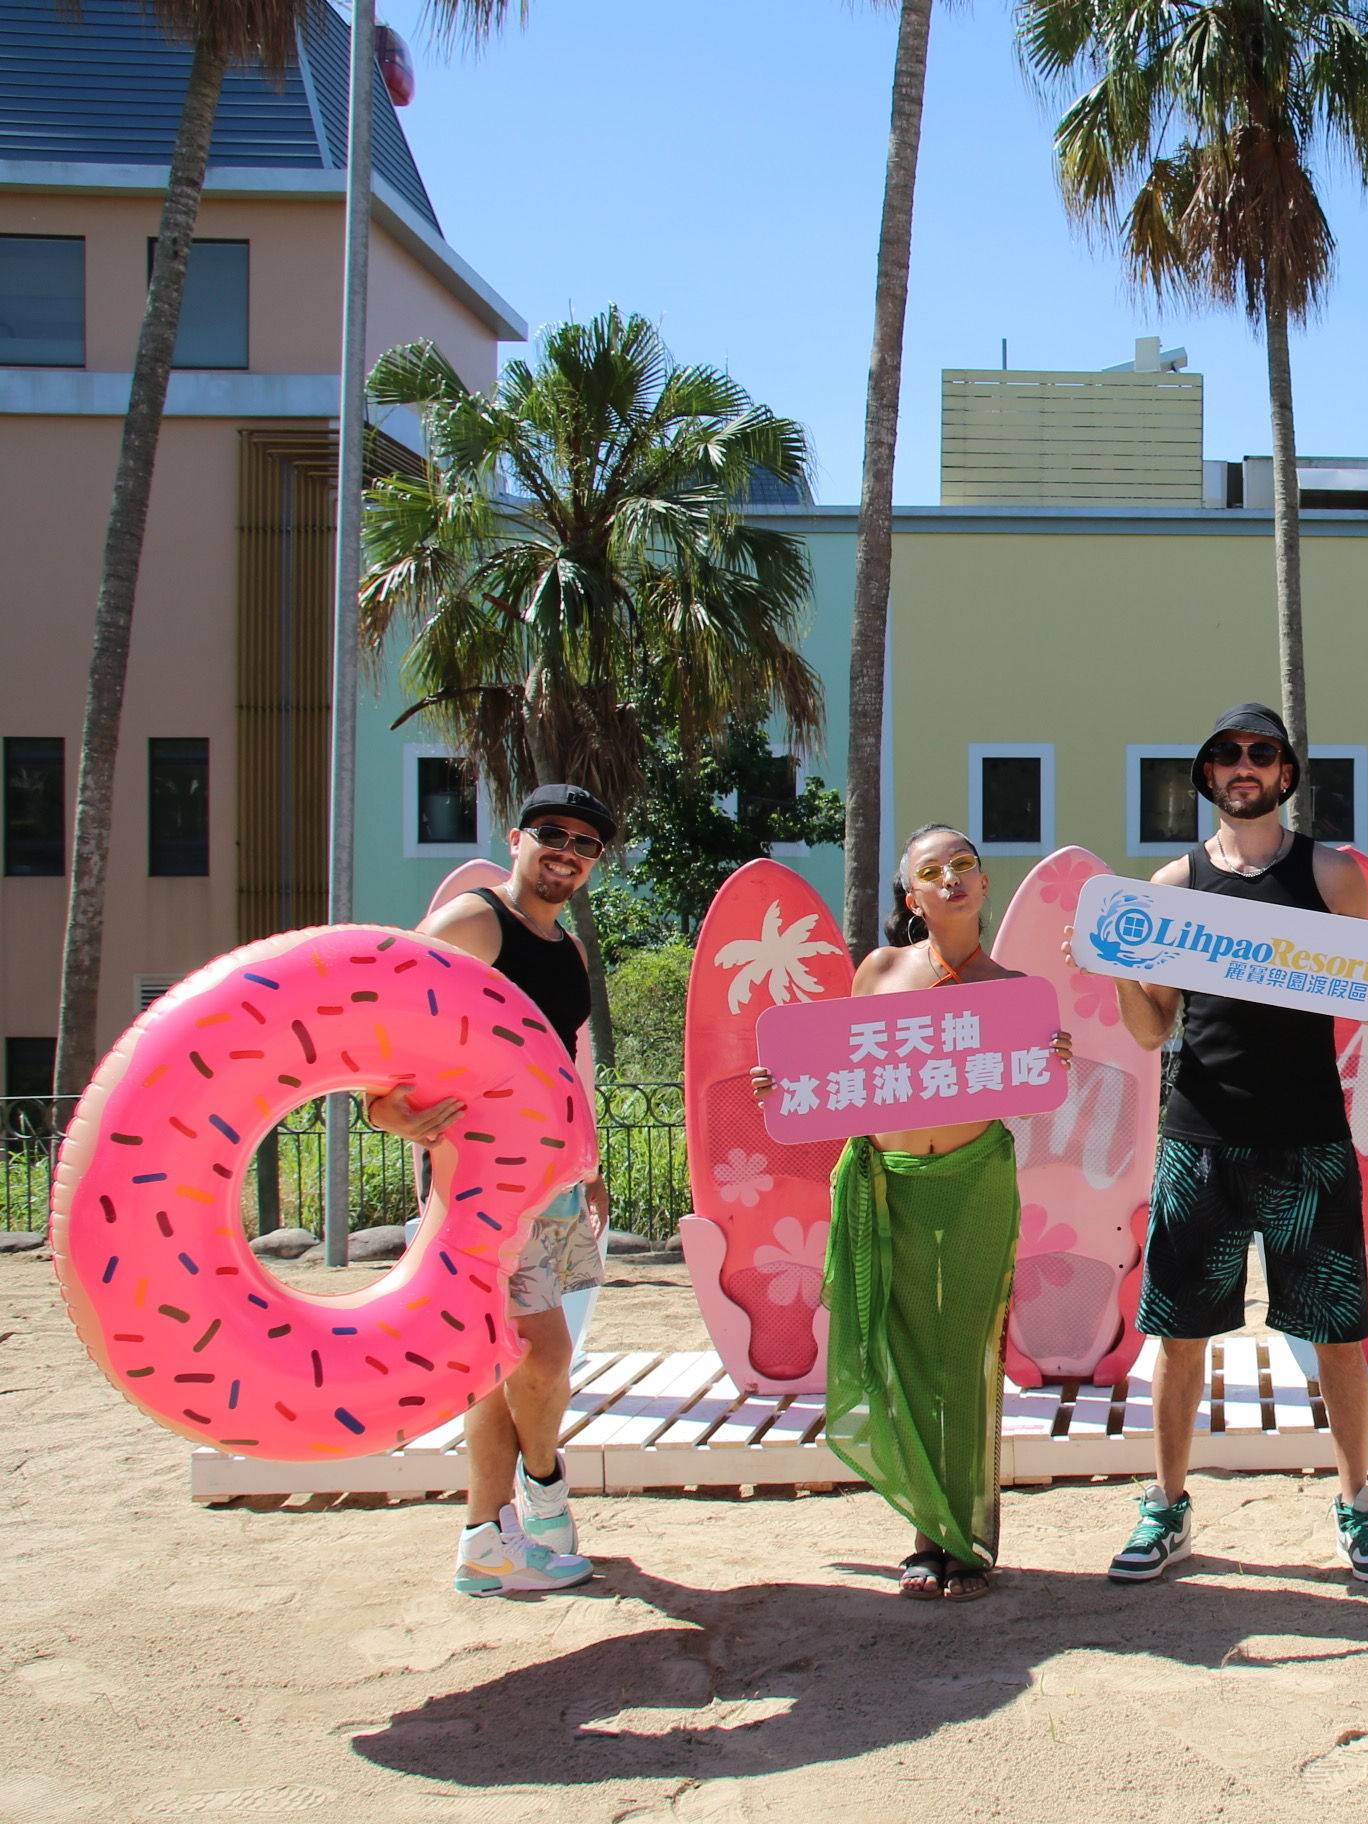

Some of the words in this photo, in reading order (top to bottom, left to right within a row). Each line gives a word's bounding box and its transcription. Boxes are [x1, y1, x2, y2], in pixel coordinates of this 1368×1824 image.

[848, 1010, 981, 1063] 天天抽
[779, 1046, 1050, 1116] 冰淇淋免費吃
